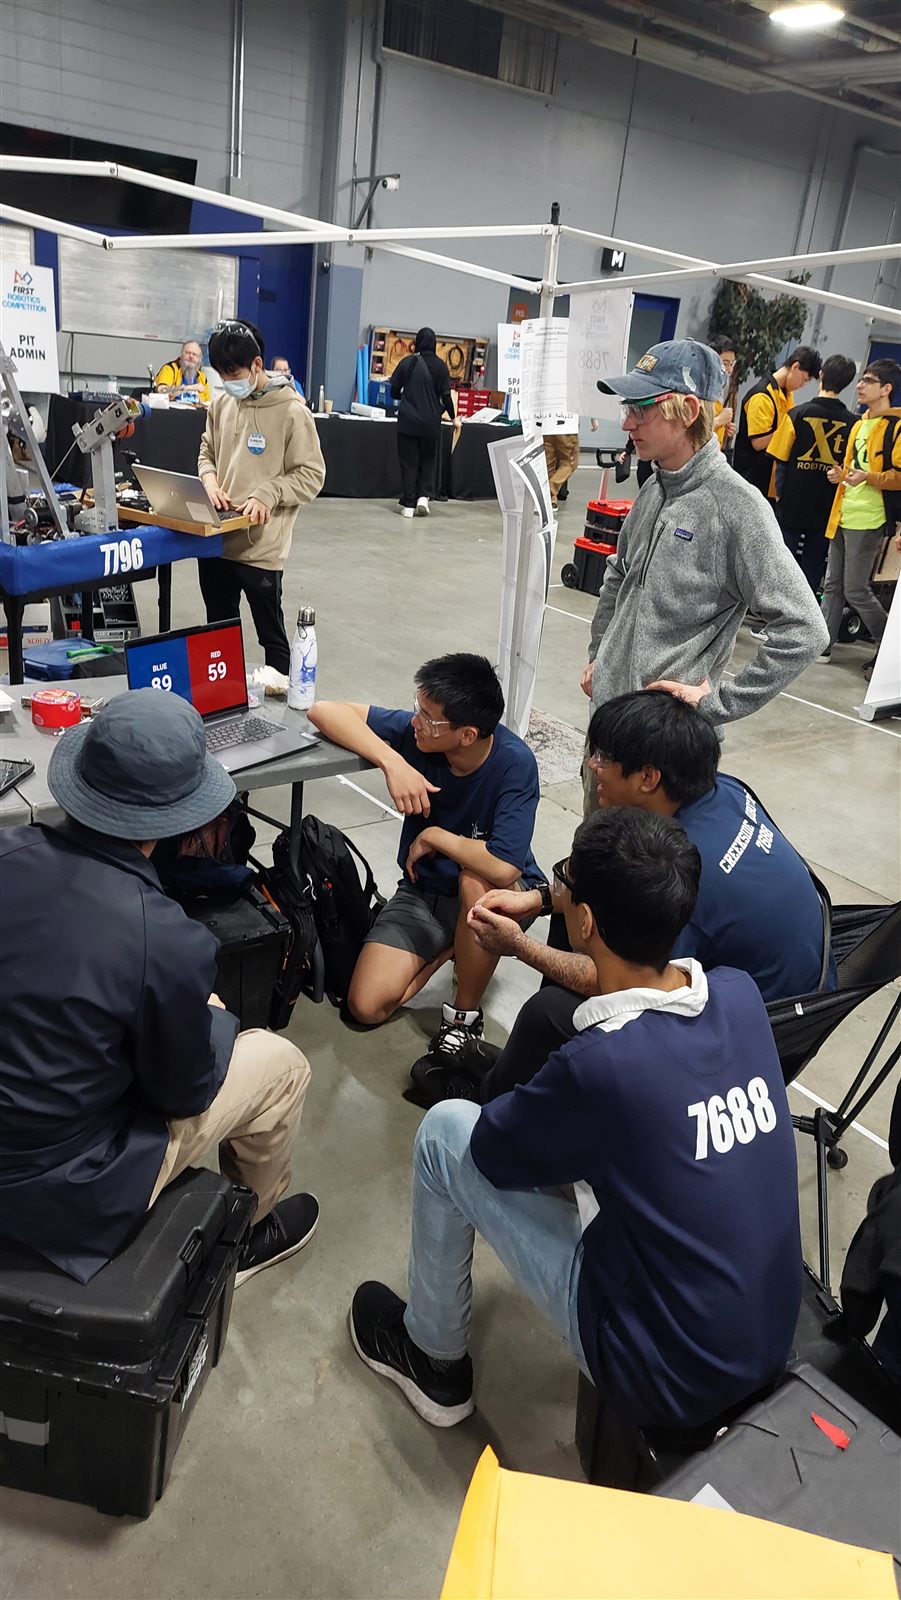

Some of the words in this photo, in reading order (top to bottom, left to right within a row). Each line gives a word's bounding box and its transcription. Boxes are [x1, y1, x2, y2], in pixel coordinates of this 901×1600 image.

[611, 250, 625, 268] M
[13, 285, 35, 295] FIRST
[7, 293, 41, 304] ROBOTICS
[2, 300, 47, 312] COMPETITION
[19, 334, 36, 346] PIT
[9, 347, 46, 360] ADMIN
[508, 377, 520, 386] SPA
[100, 538, 144, 577] 7796
[210, 650, 222, 659] RED
[152, 662, 168, 673] BLUE
[208, 661, 227, 682] 59
[755, 823, 774, 855] 7688
[719, 818, 755, 874] CREEKSIDE
[687, 1076, 777, 1161] 7688
